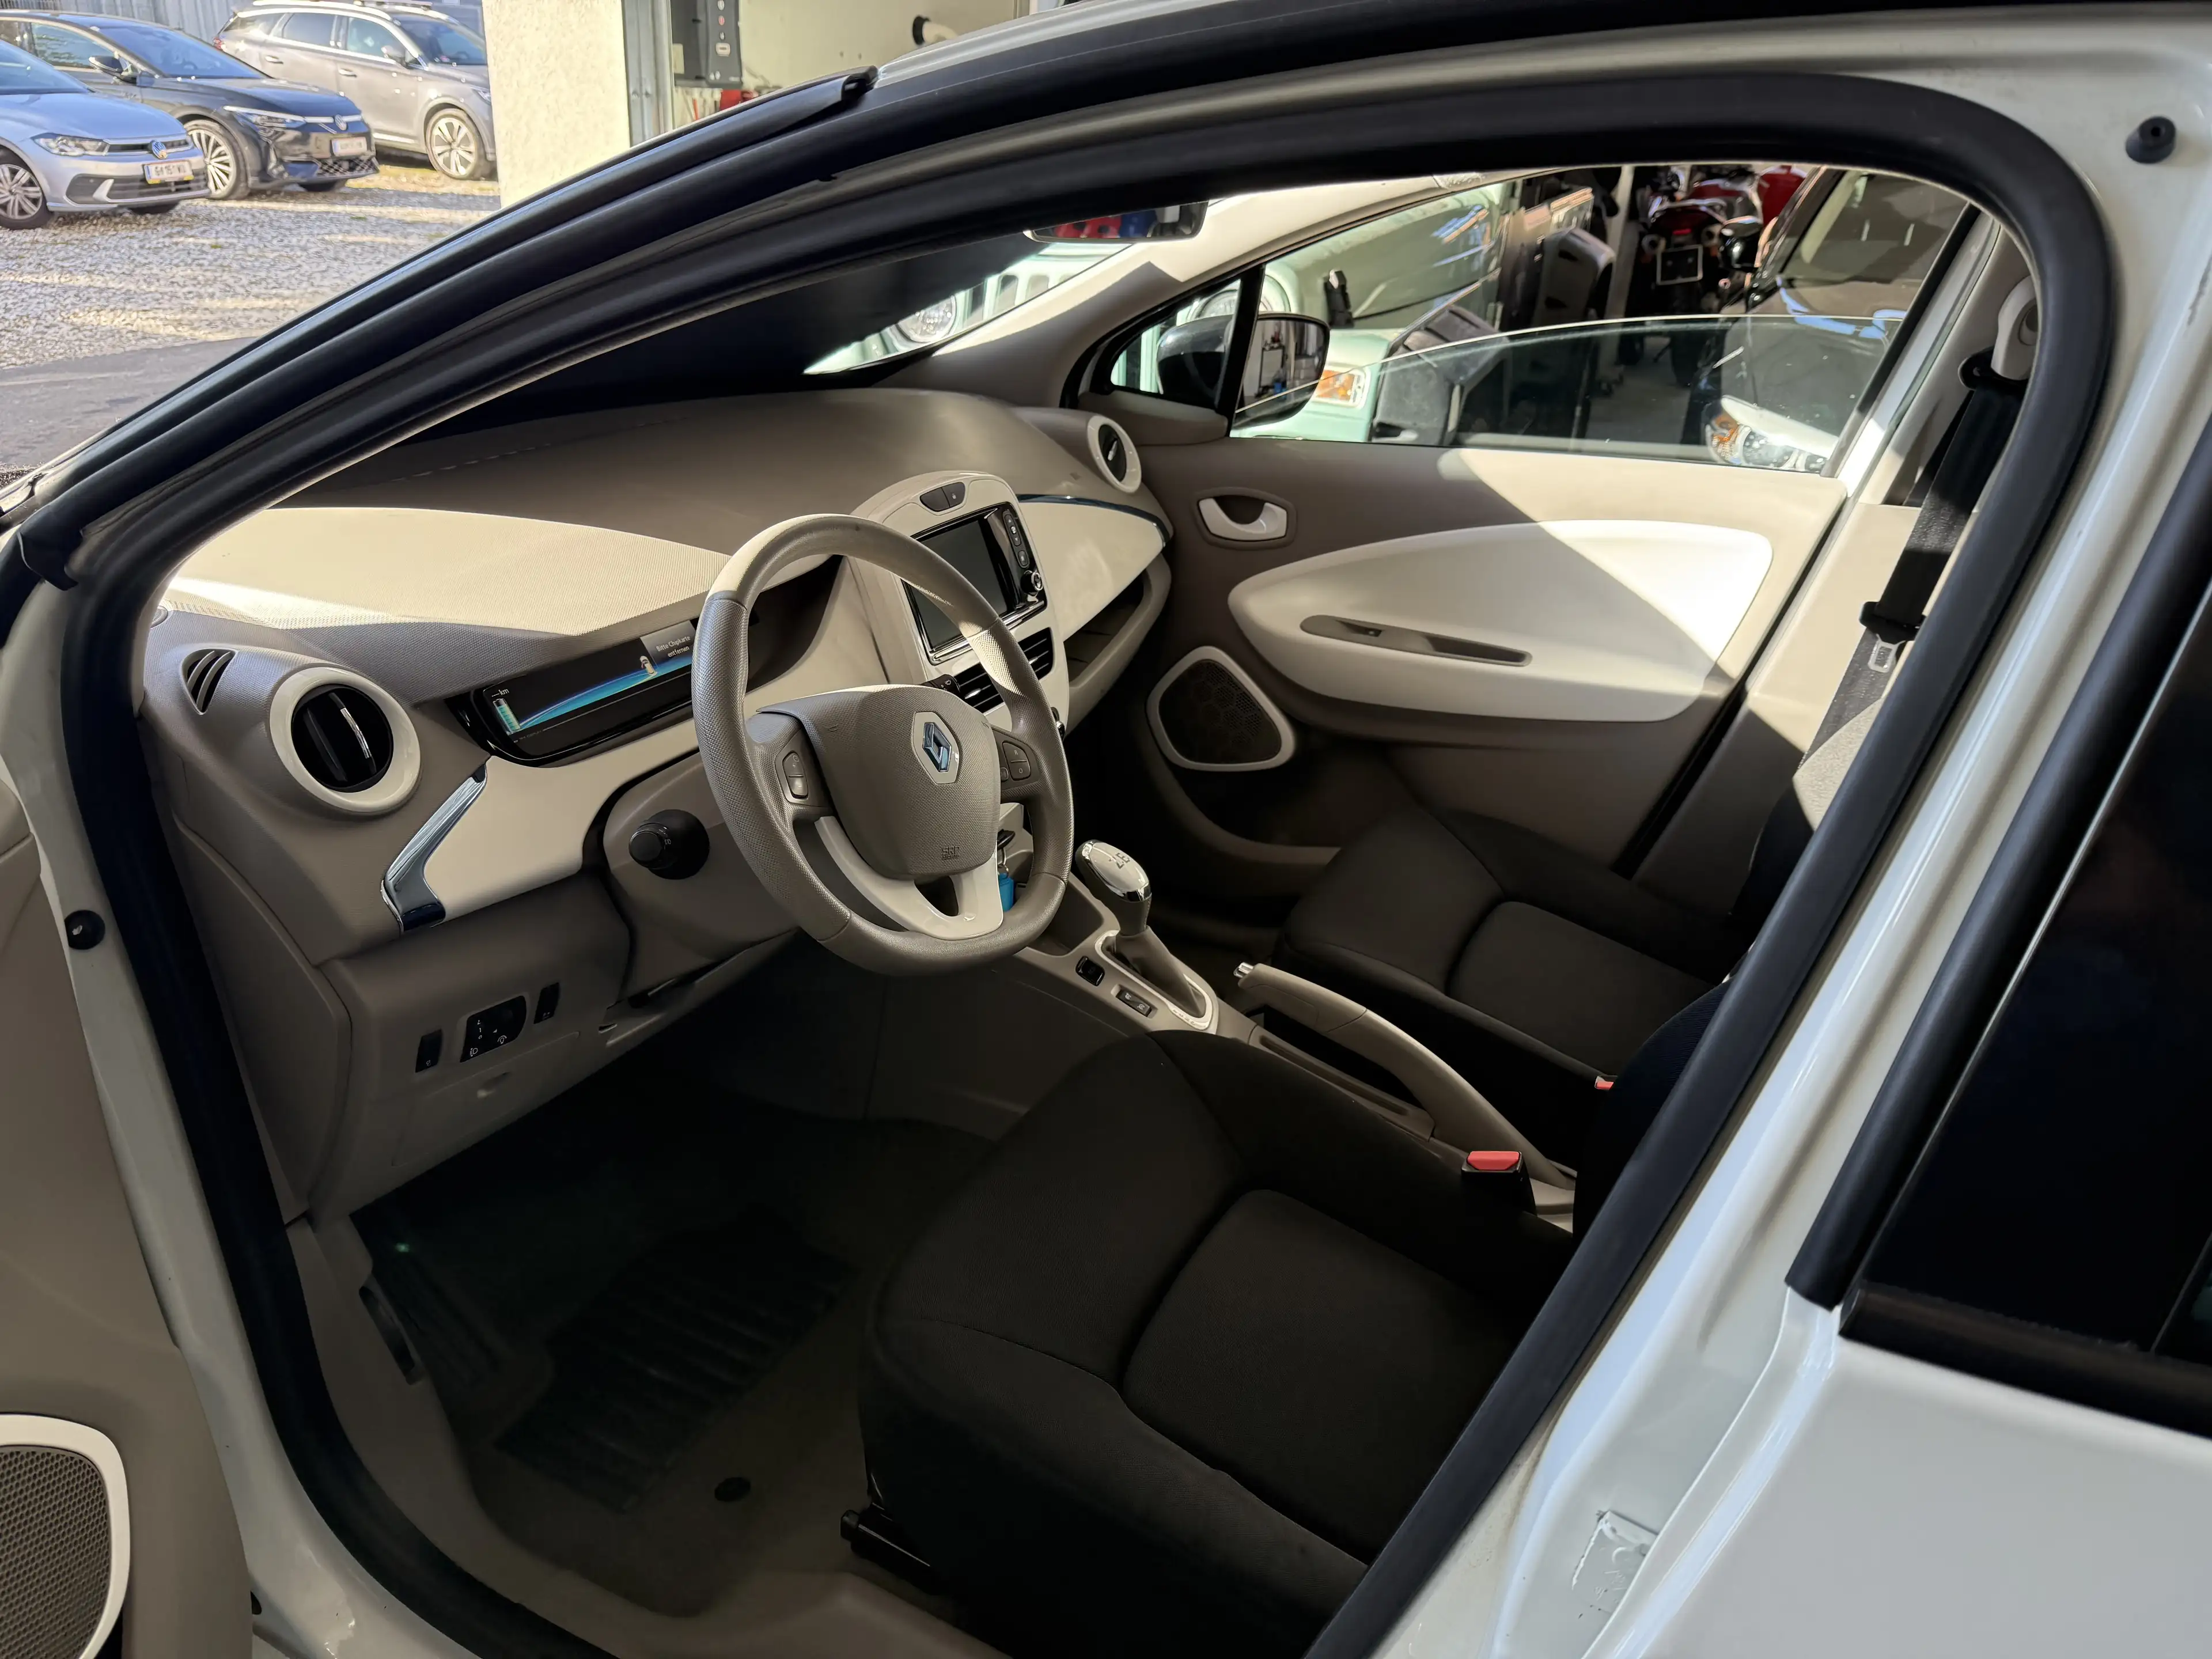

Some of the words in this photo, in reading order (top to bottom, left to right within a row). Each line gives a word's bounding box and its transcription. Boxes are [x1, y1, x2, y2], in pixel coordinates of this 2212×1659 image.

[656, 643, 669, 652] Bitte
[668, 636, 691, 647] Chipkarte
[668, 646, 690, 657] entfernen
